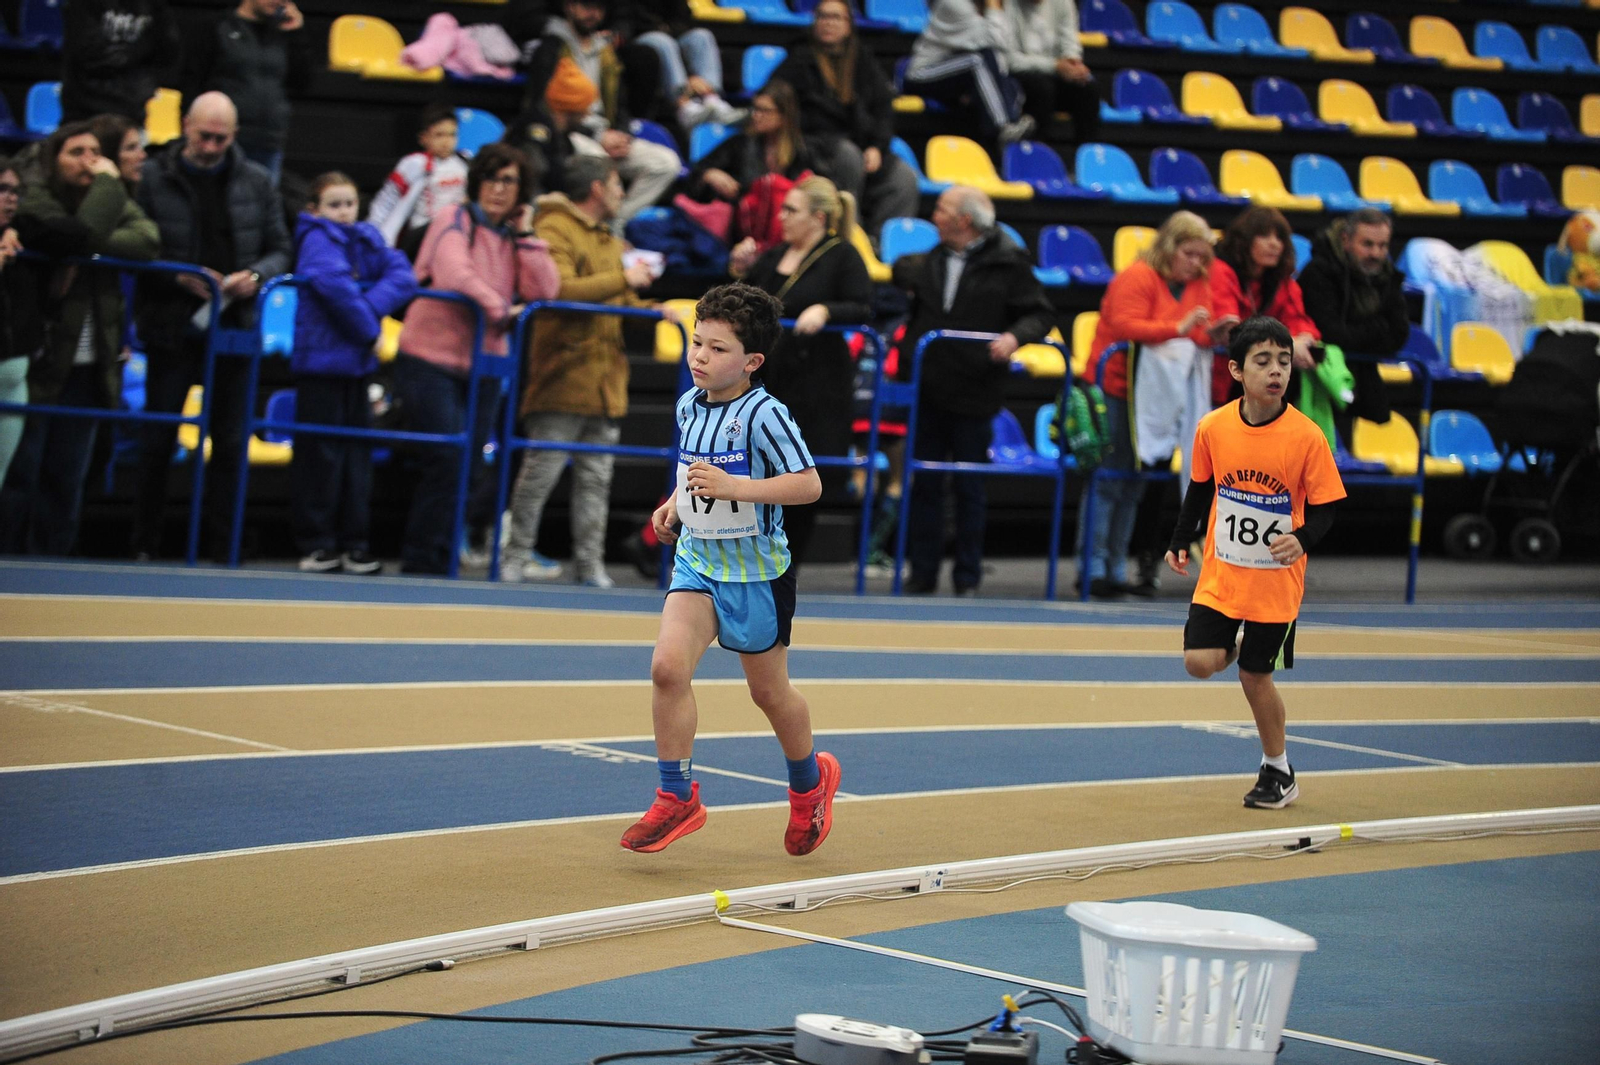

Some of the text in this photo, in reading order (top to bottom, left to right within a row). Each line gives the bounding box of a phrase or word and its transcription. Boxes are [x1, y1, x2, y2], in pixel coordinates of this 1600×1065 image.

[680, 452, 744, 463] OURENSE 2026
[1219, 488, 1289, 505] OURENSE 2026
[717, 525, 755, 534] atletismo.gal
[1225, 514, 1283, 546] 186
